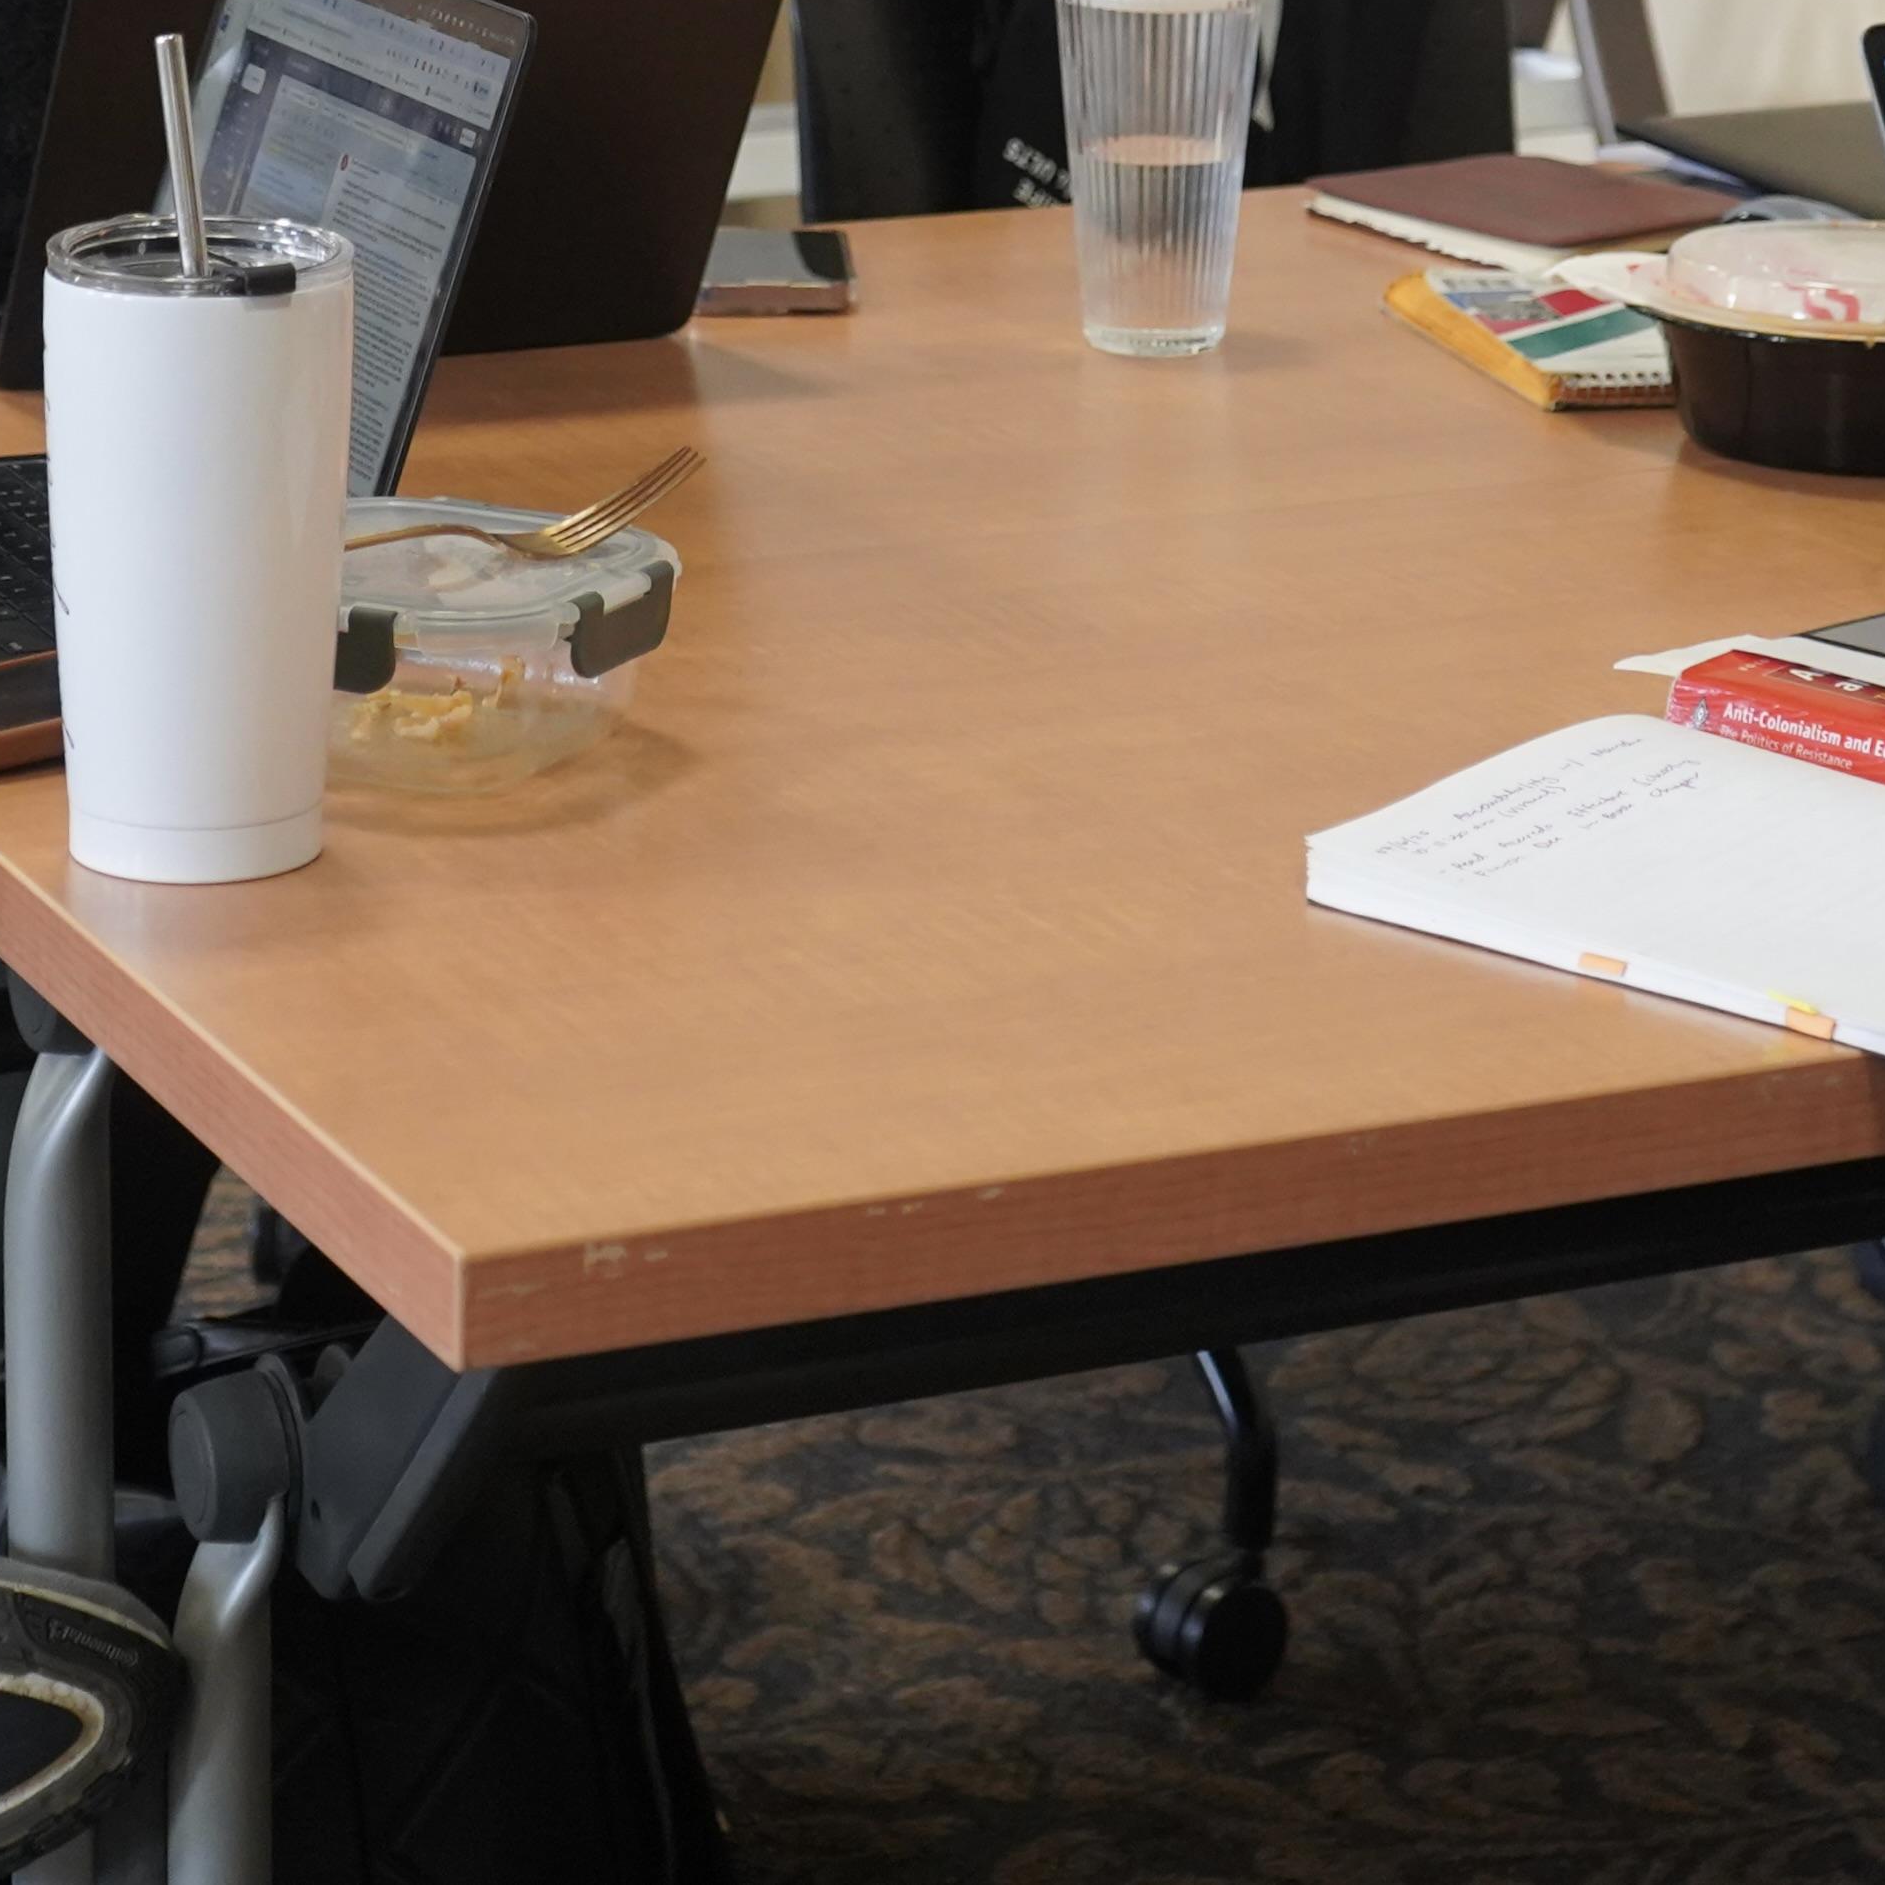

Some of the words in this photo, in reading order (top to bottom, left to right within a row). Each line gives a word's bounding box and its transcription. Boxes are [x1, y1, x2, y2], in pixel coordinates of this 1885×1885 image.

[1719, 725, 1738, 738] The
[1740, 729, 1779, 751] Politics
[1782, 741, 1793, 754] of
[1796, 747, 1853, 770] Resistance
[1723, 702, 1841, 747] Anti-Colonialism
[1844, 735, 1871, 755] and
